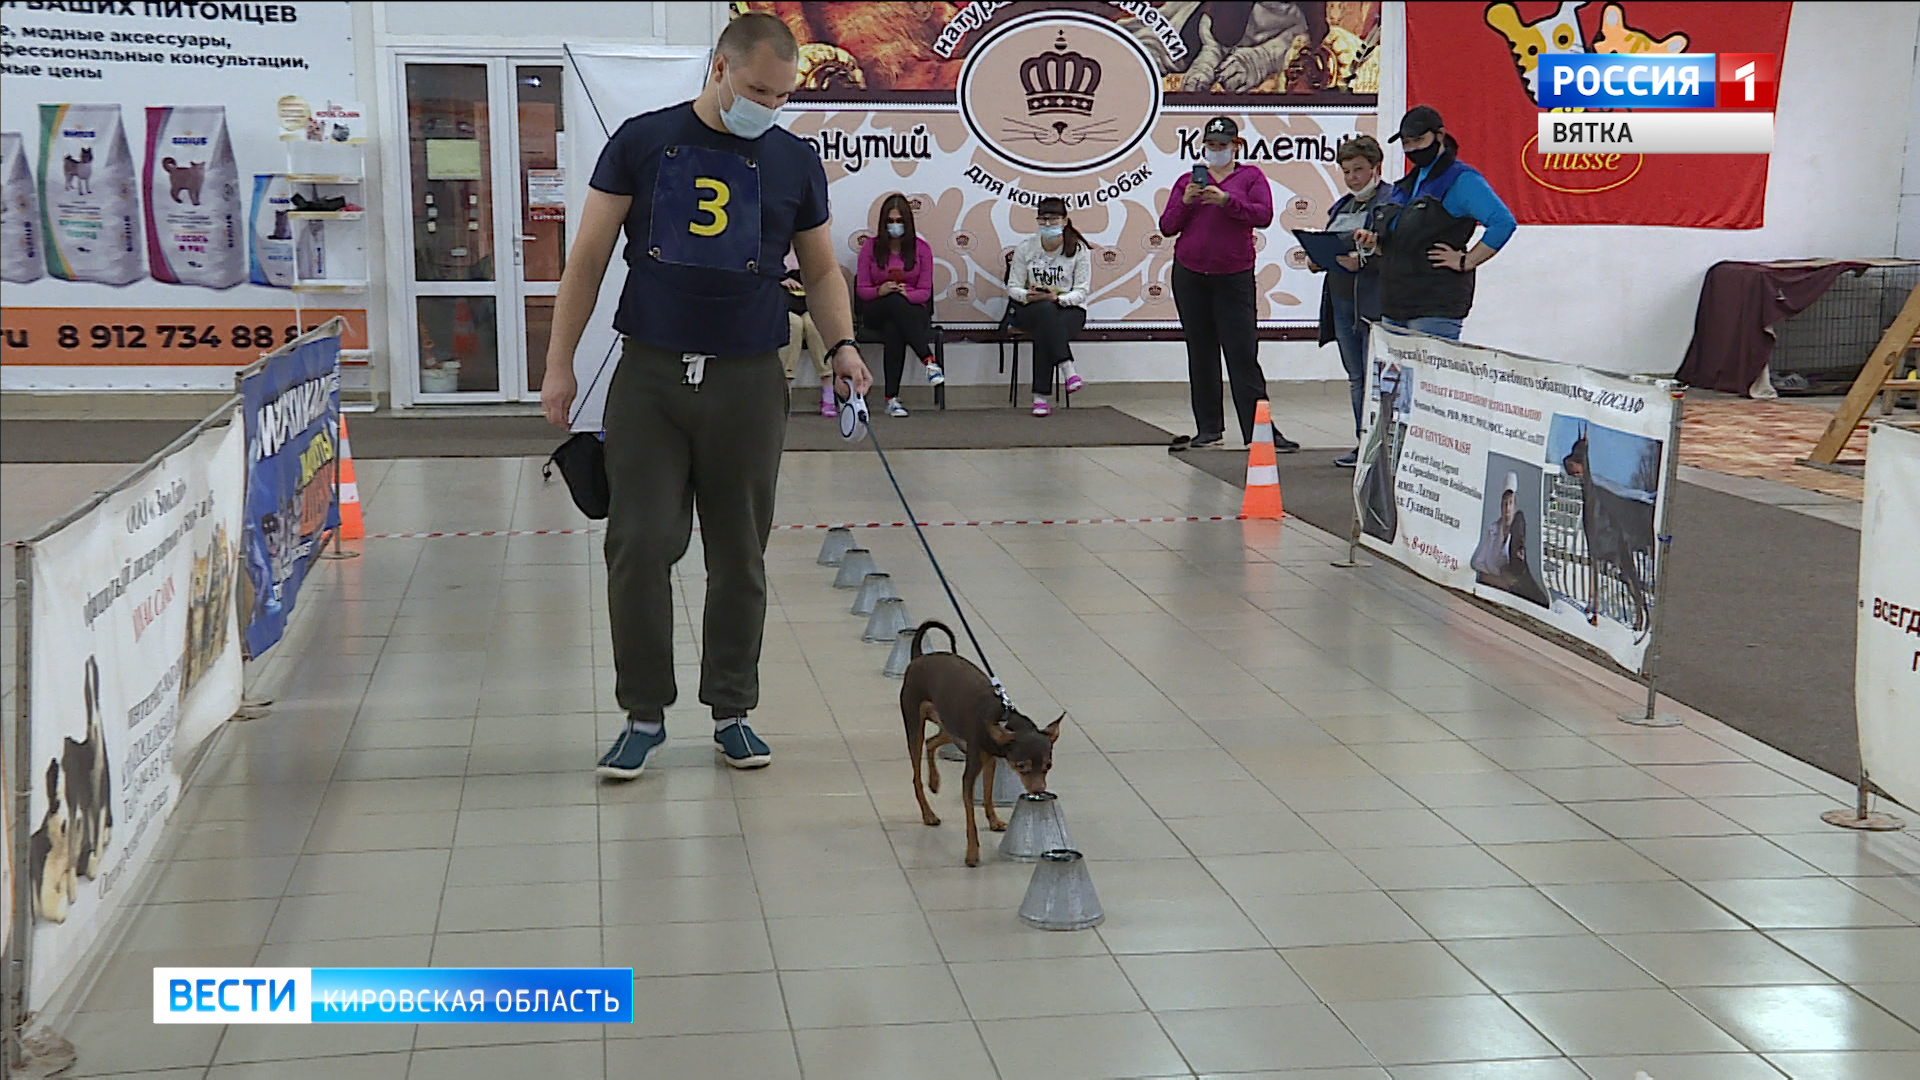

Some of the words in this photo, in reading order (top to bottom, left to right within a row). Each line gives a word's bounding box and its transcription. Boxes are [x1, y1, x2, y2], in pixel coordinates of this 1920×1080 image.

[143, 1, 297, 26] ПИТОМЦЕВ
[21, 26, 105, 42] модные
[110, 31, 232, 50] аксессуары,
[935, 1, 1006, 56] натур
[1120, 1, 1185, 58] летки
[48, 66, 103, 80] цены
[170, 53, 310, 70] консультации,
[964, 164, 1004, 195] для
[1007, 187, 1072, 209] кошк
[1077, 192, 1091, 208] и
[1096, 165, 1153, 203] собак
[689, 177, 730, 236] 3
[57, 325, 80, 348] 8
[89, 325, 147, 348] 912
[156, 325, 221, 348] 734
[231, 325, 274, 348] 88
